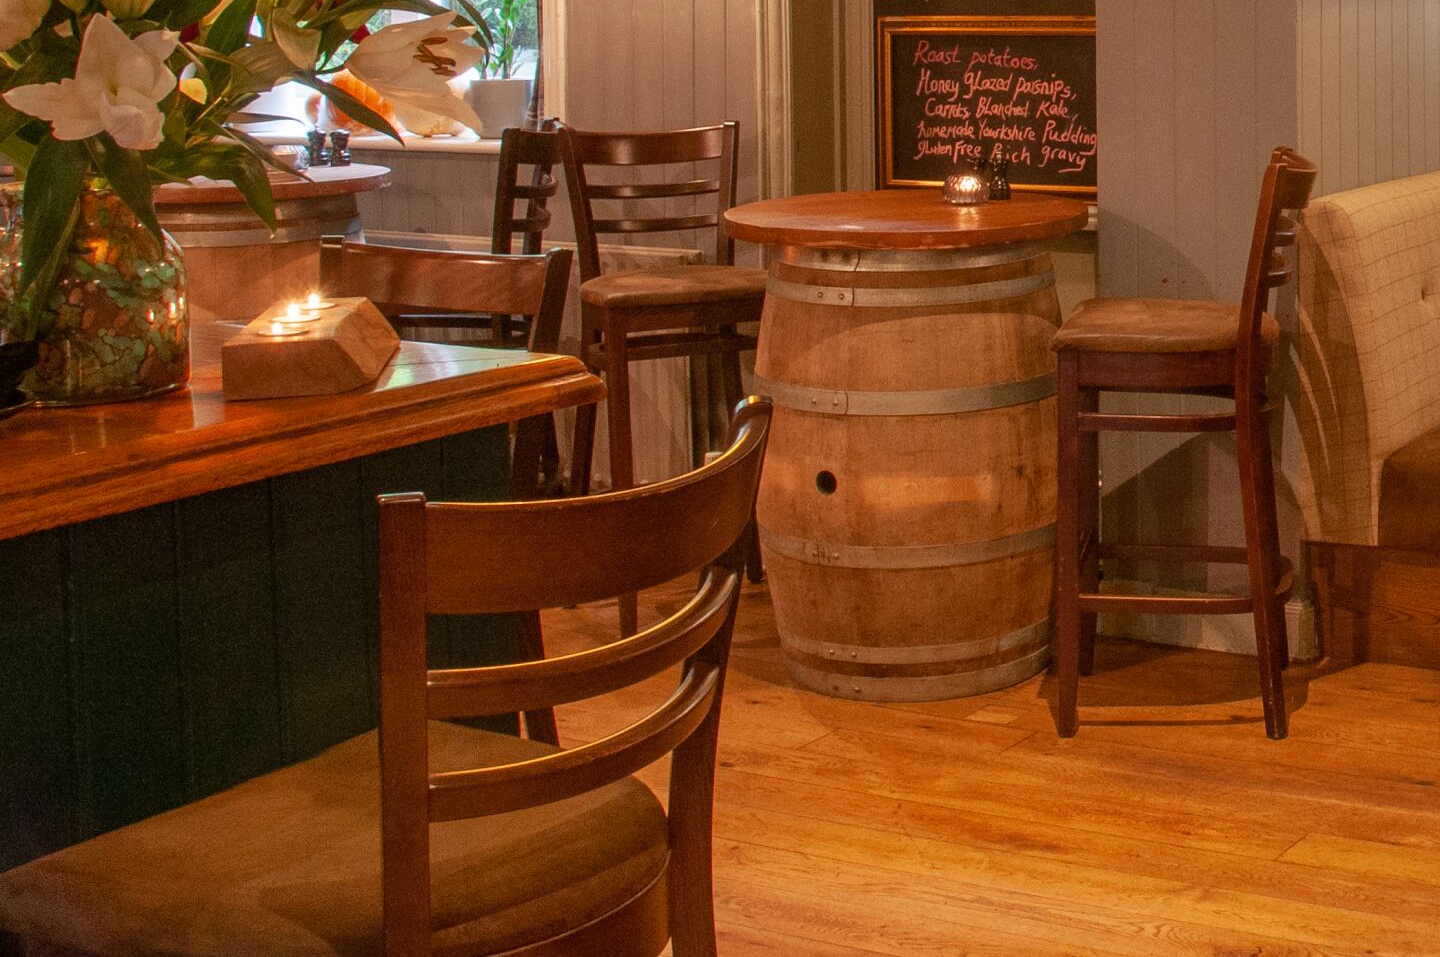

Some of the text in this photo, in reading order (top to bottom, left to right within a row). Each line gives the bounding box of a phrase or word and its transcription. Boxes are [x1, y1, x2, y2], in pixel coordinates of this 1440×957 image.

[913, 40, 961, 67] Roast
[916, 67, 959, 101] Honey
[953, 139, 982, 163] Free
[990, 143, 1031, 165] Rich
[1038, 145, 1087, 173] gravy
